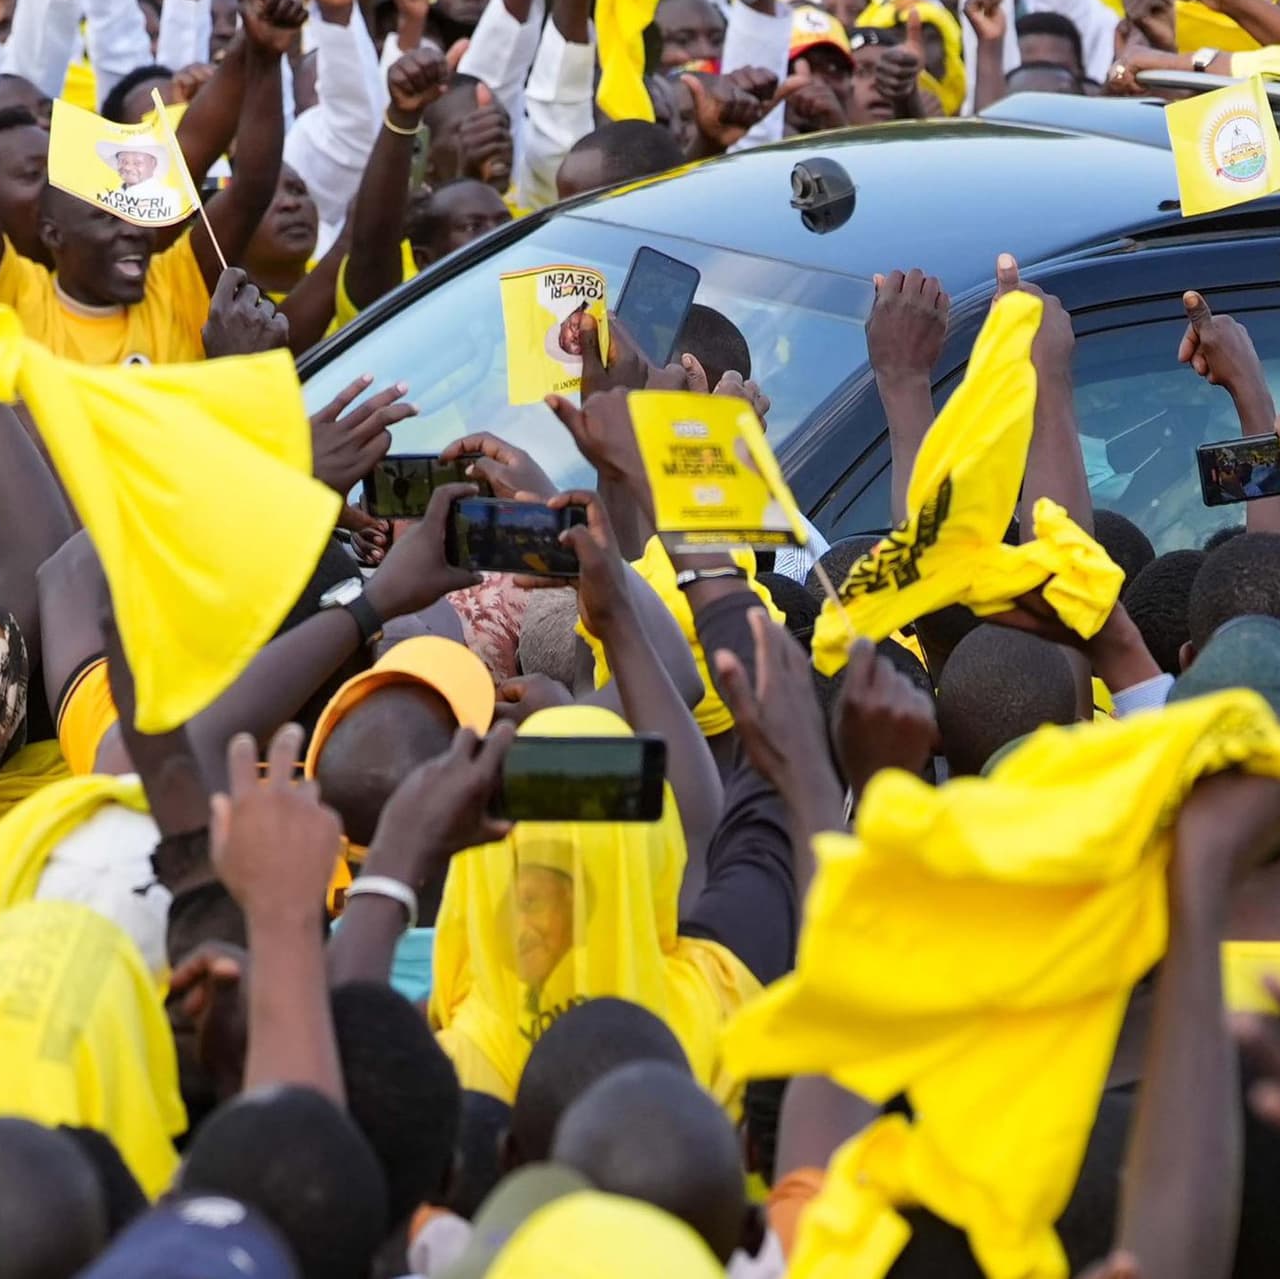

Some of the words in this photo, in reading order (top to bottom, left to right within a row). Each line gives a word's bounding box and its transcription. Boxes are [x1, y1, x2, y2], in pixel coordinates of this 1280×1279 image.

[96, 192, 172, 219] MUSEVENI
[105, 187, 164, 207] YOWERI
[544, 272, 604, 290] USEVENI
